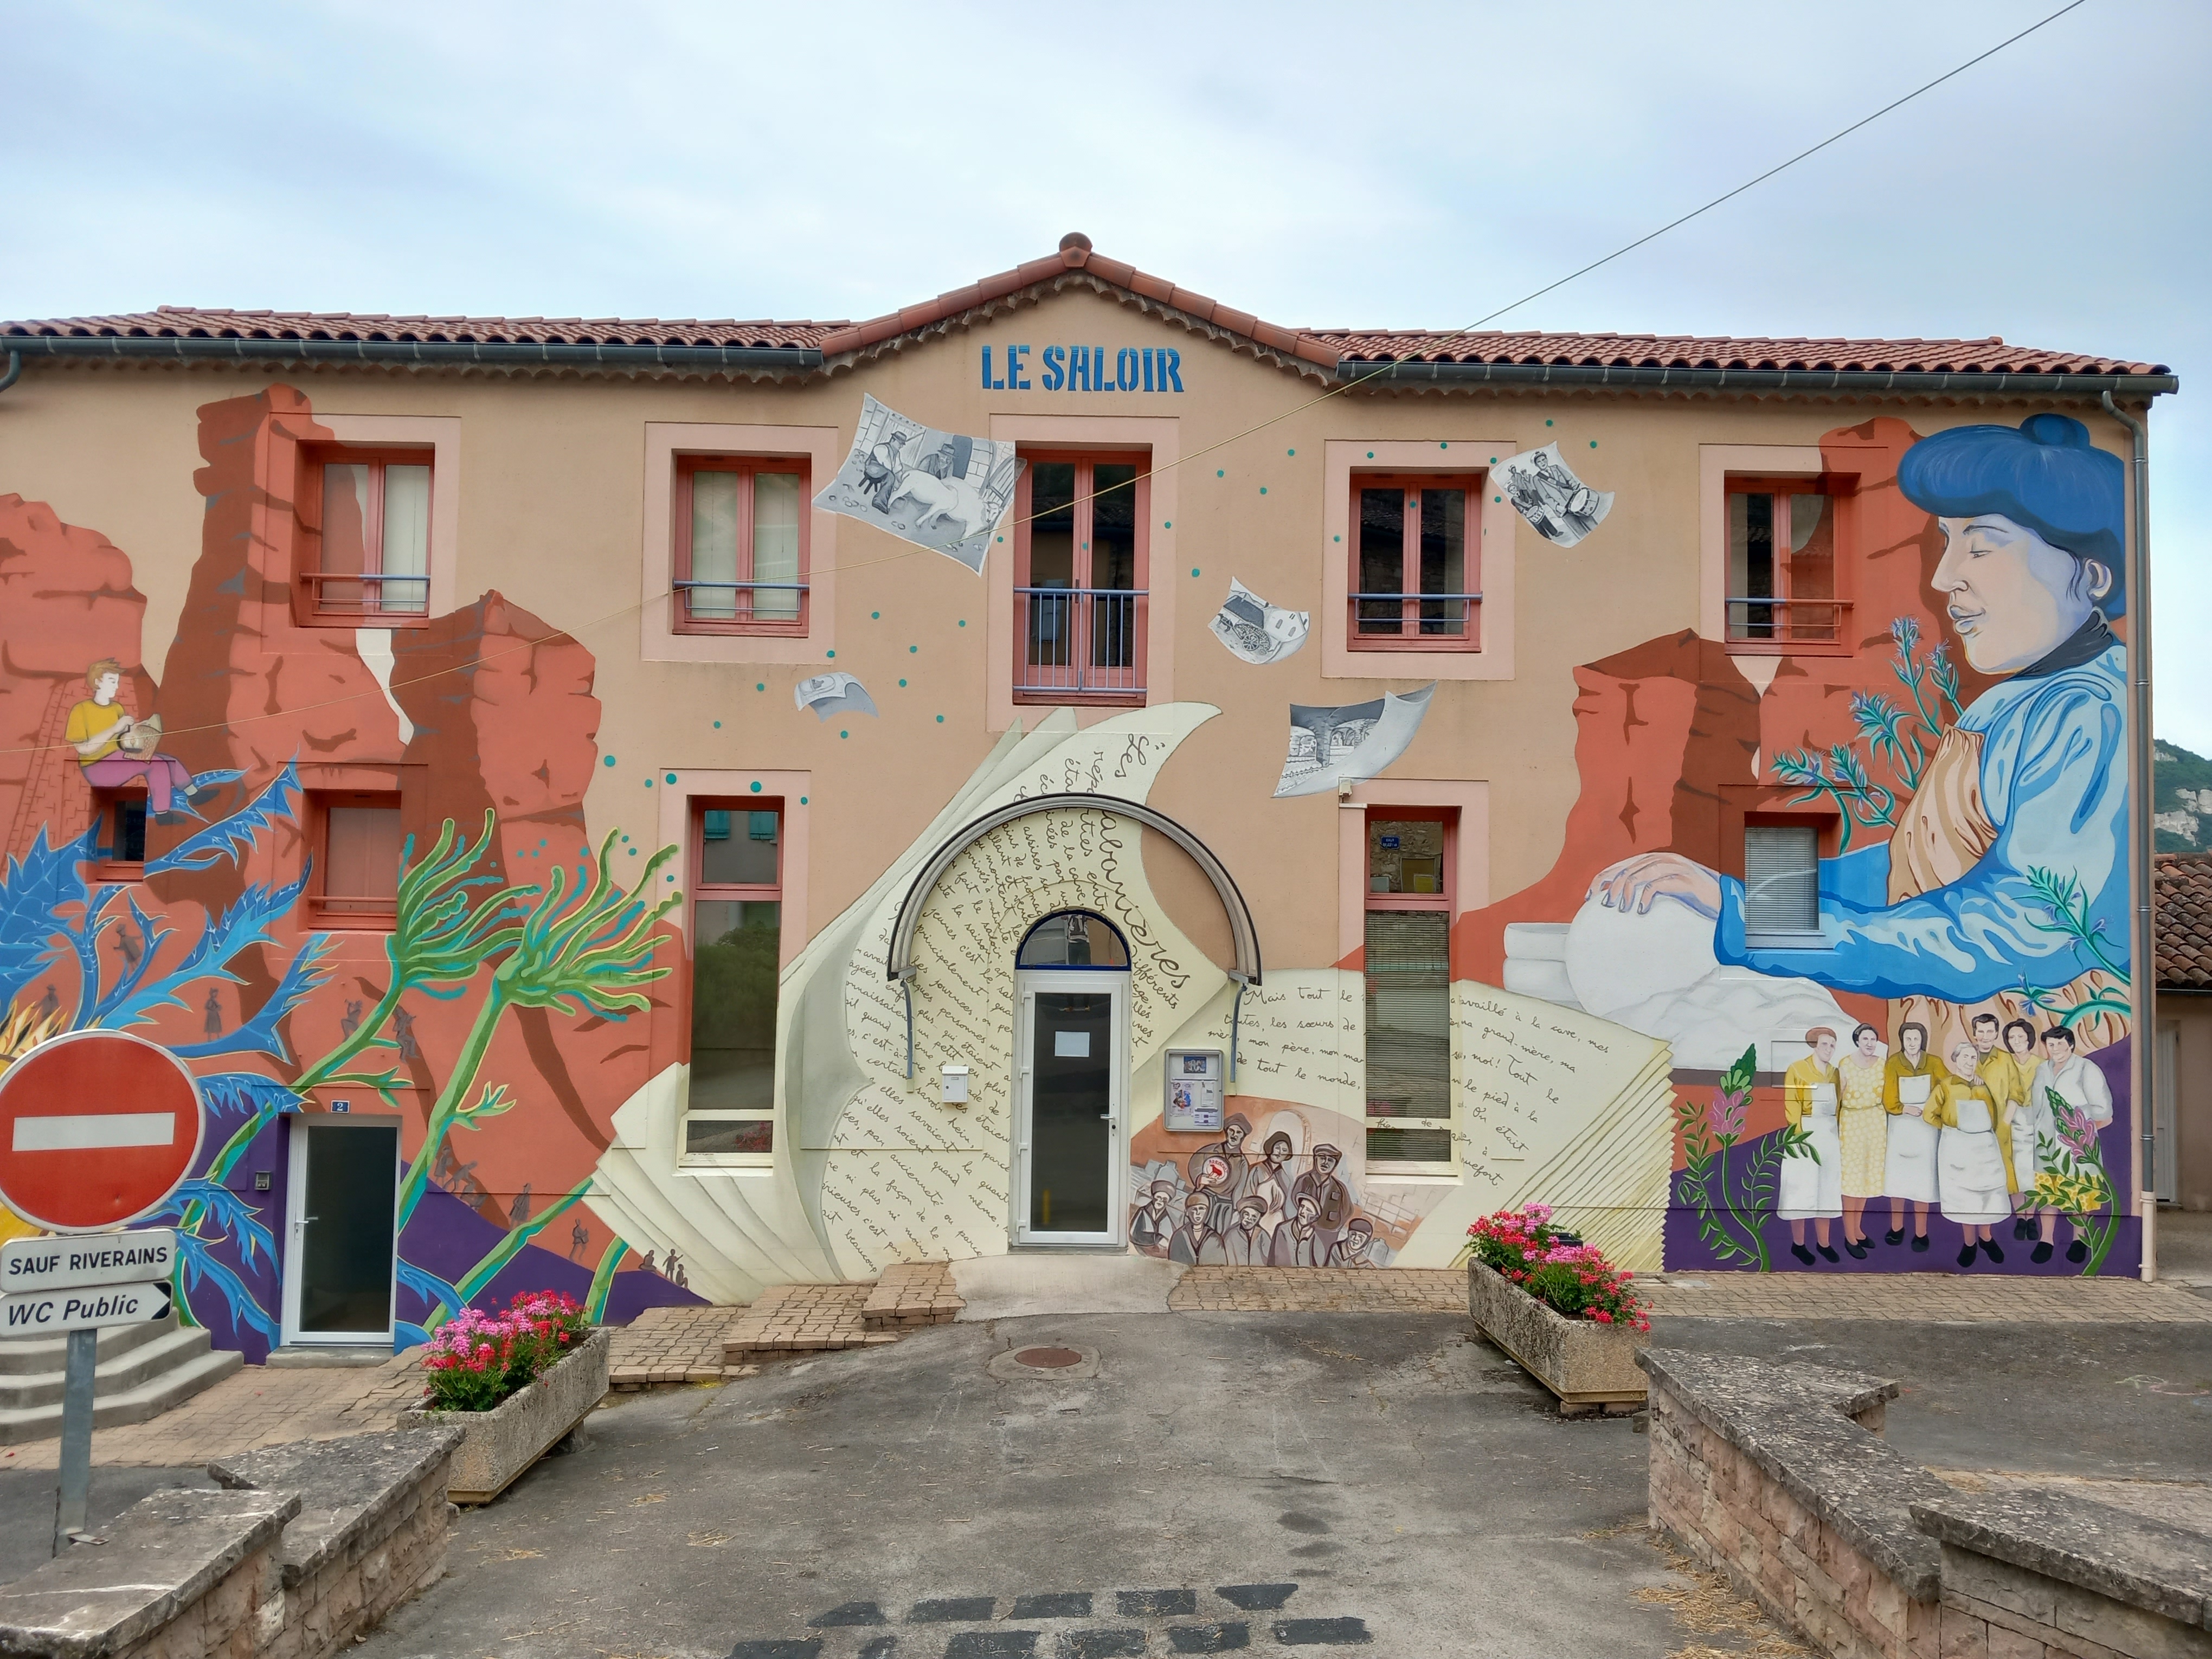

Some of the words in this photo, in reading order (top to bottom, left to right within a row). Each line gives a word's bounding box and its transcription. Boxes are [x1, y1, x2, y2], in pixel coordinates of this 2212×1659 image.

[982, 345, 1031, 390] LE
[1042, 345, 1185, 392] SALOIR
[1002, 822, 1019, 849] ains
[1017, 874, 1044, 918] fromag
[1099, 811, 1191, 989] abanières
[1243, 988, 1287, 1006] Mais
[336, 1102, 344, 1111] 2
[842, 1111, 861, 1131] ées,
[821, 1179, 861, 1217] érieuses
[8, 1255, 61, 1275] SAUF
[69, 1246, 168, 1271] RIVERAINS
[9, 1301, 54, 1326] WC
[62, 1294, 139, 1321] Public
